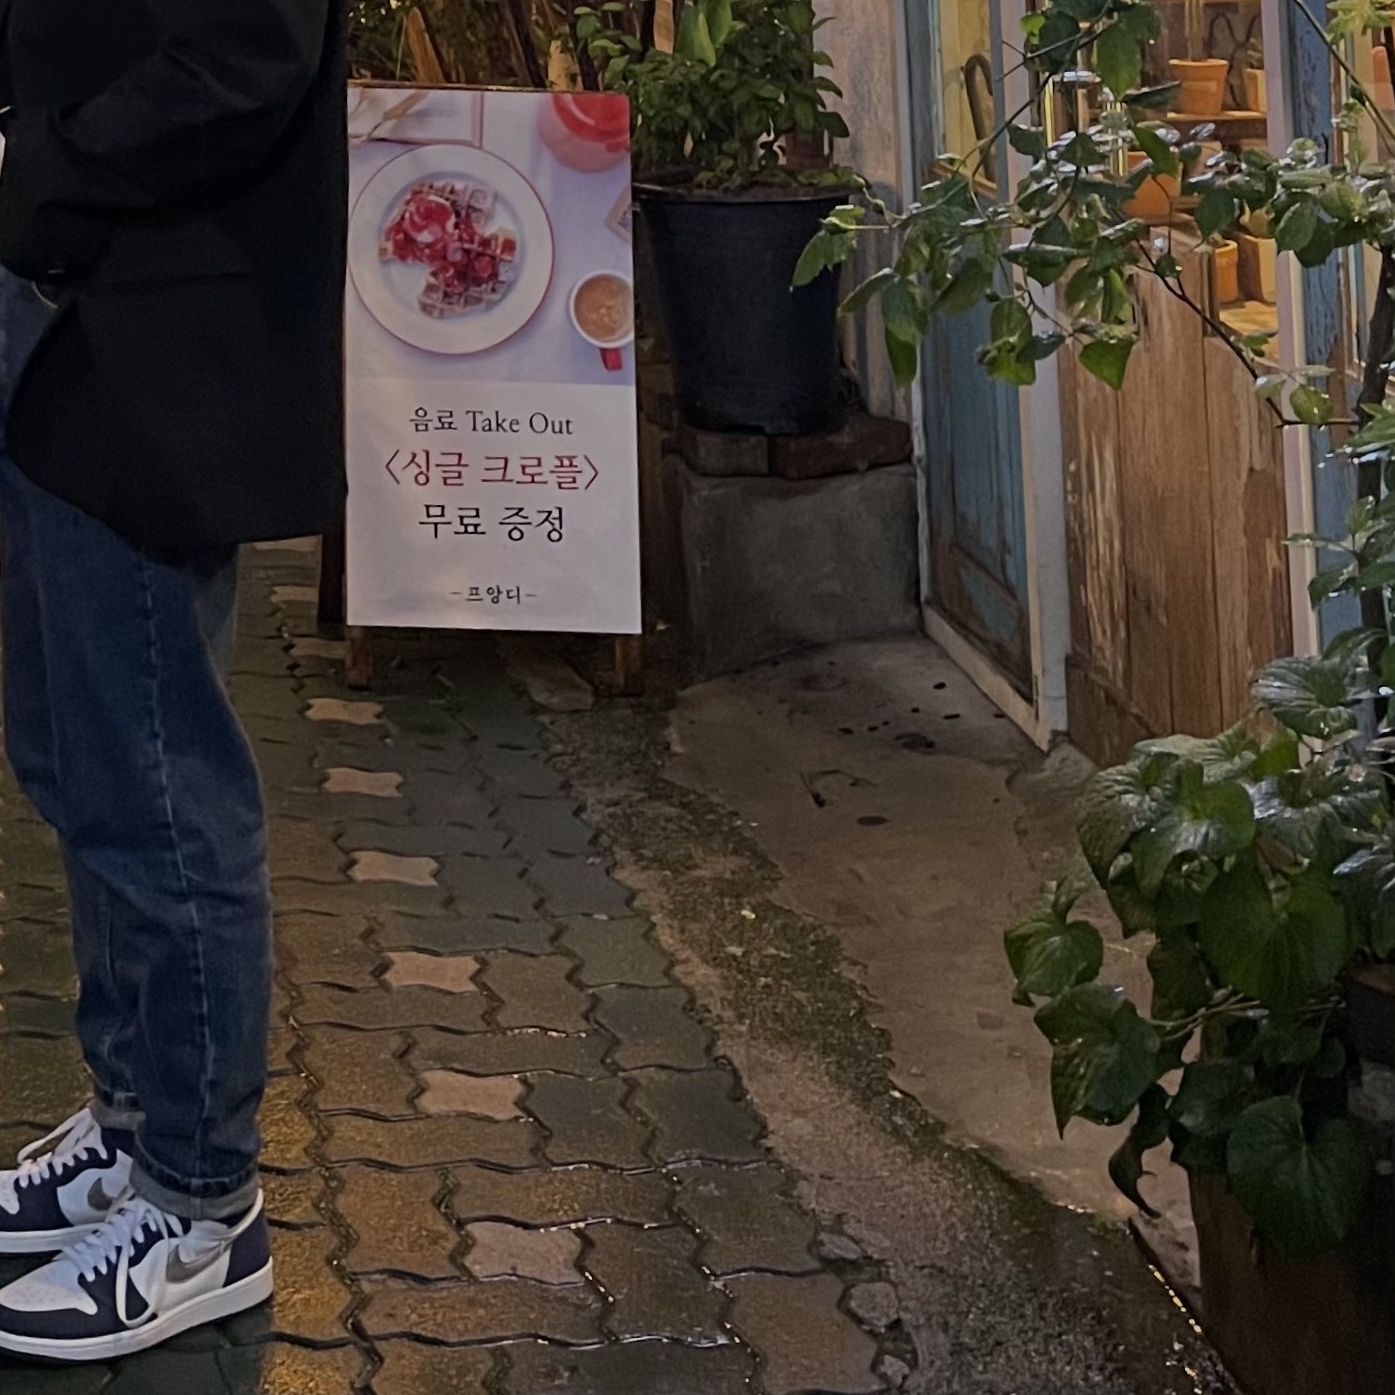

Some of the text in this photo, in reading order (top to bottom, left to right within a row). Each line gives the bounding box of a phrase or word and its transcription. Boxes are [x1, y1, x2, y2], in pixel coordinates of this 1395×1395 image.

[409, 406, 574, 436] 음료 Take Out
[418, 504, 564, 543] 무료 증정
